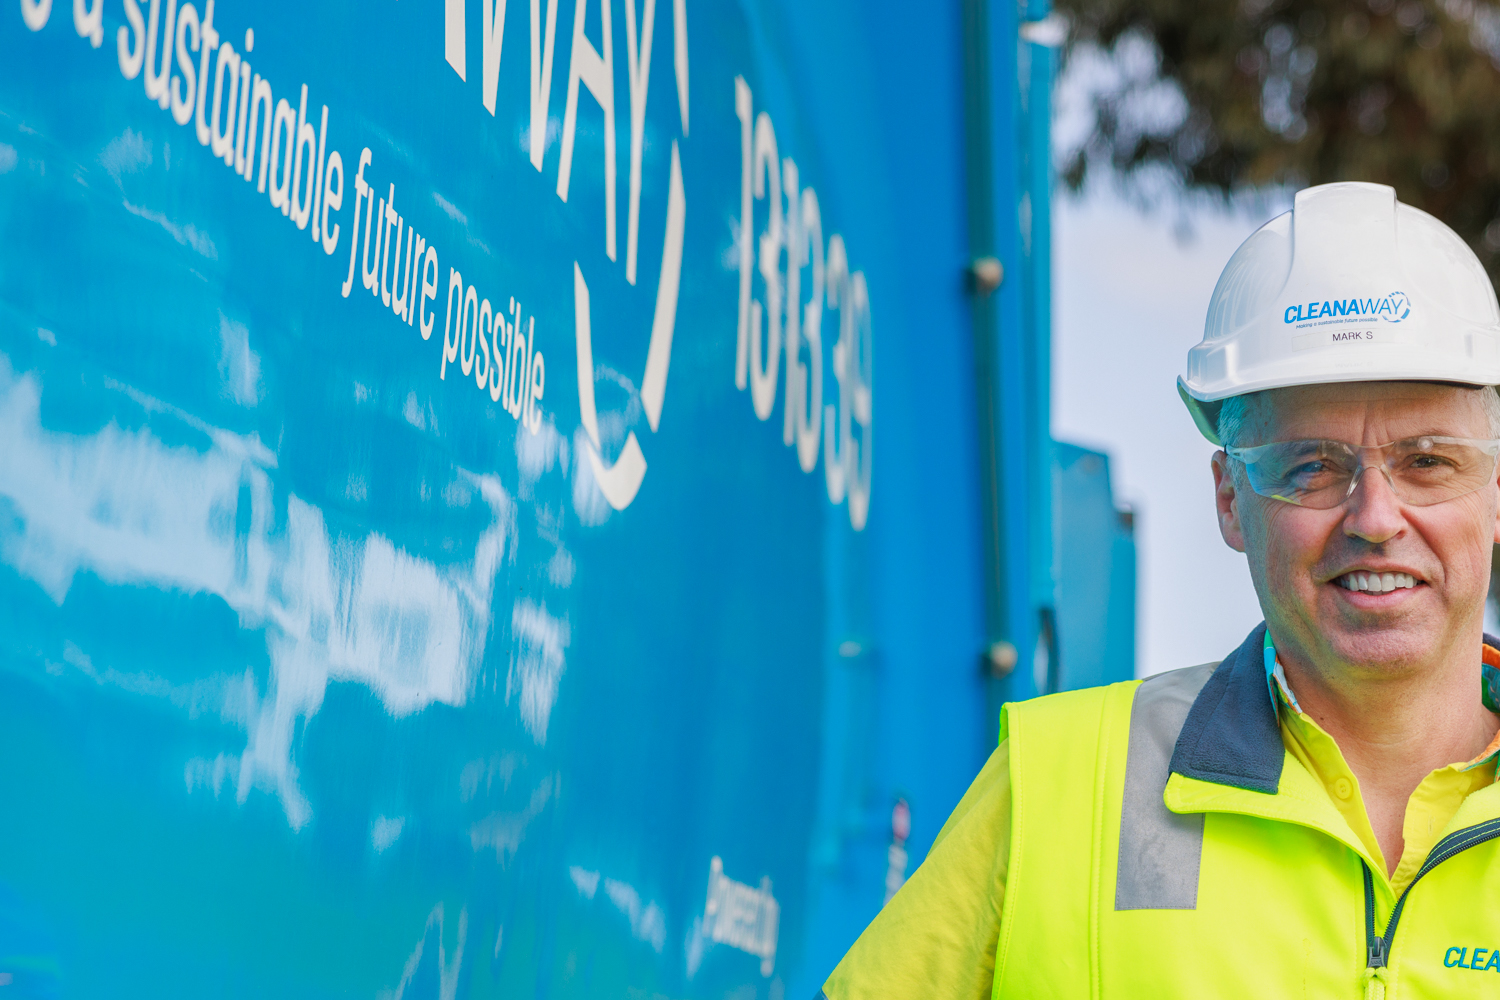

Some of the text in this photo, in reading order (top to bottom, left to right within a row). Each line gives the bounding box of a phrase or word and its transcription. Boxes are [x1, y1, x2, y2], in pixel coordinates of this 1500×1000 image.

[116, 0, 546, 436] sustainable future possible
[1284, 299, 1403, 323] CLEANAWAY
[1318, 317, 1344, 326] sustainable
[1332, 330, 1374, 341] MARK S
